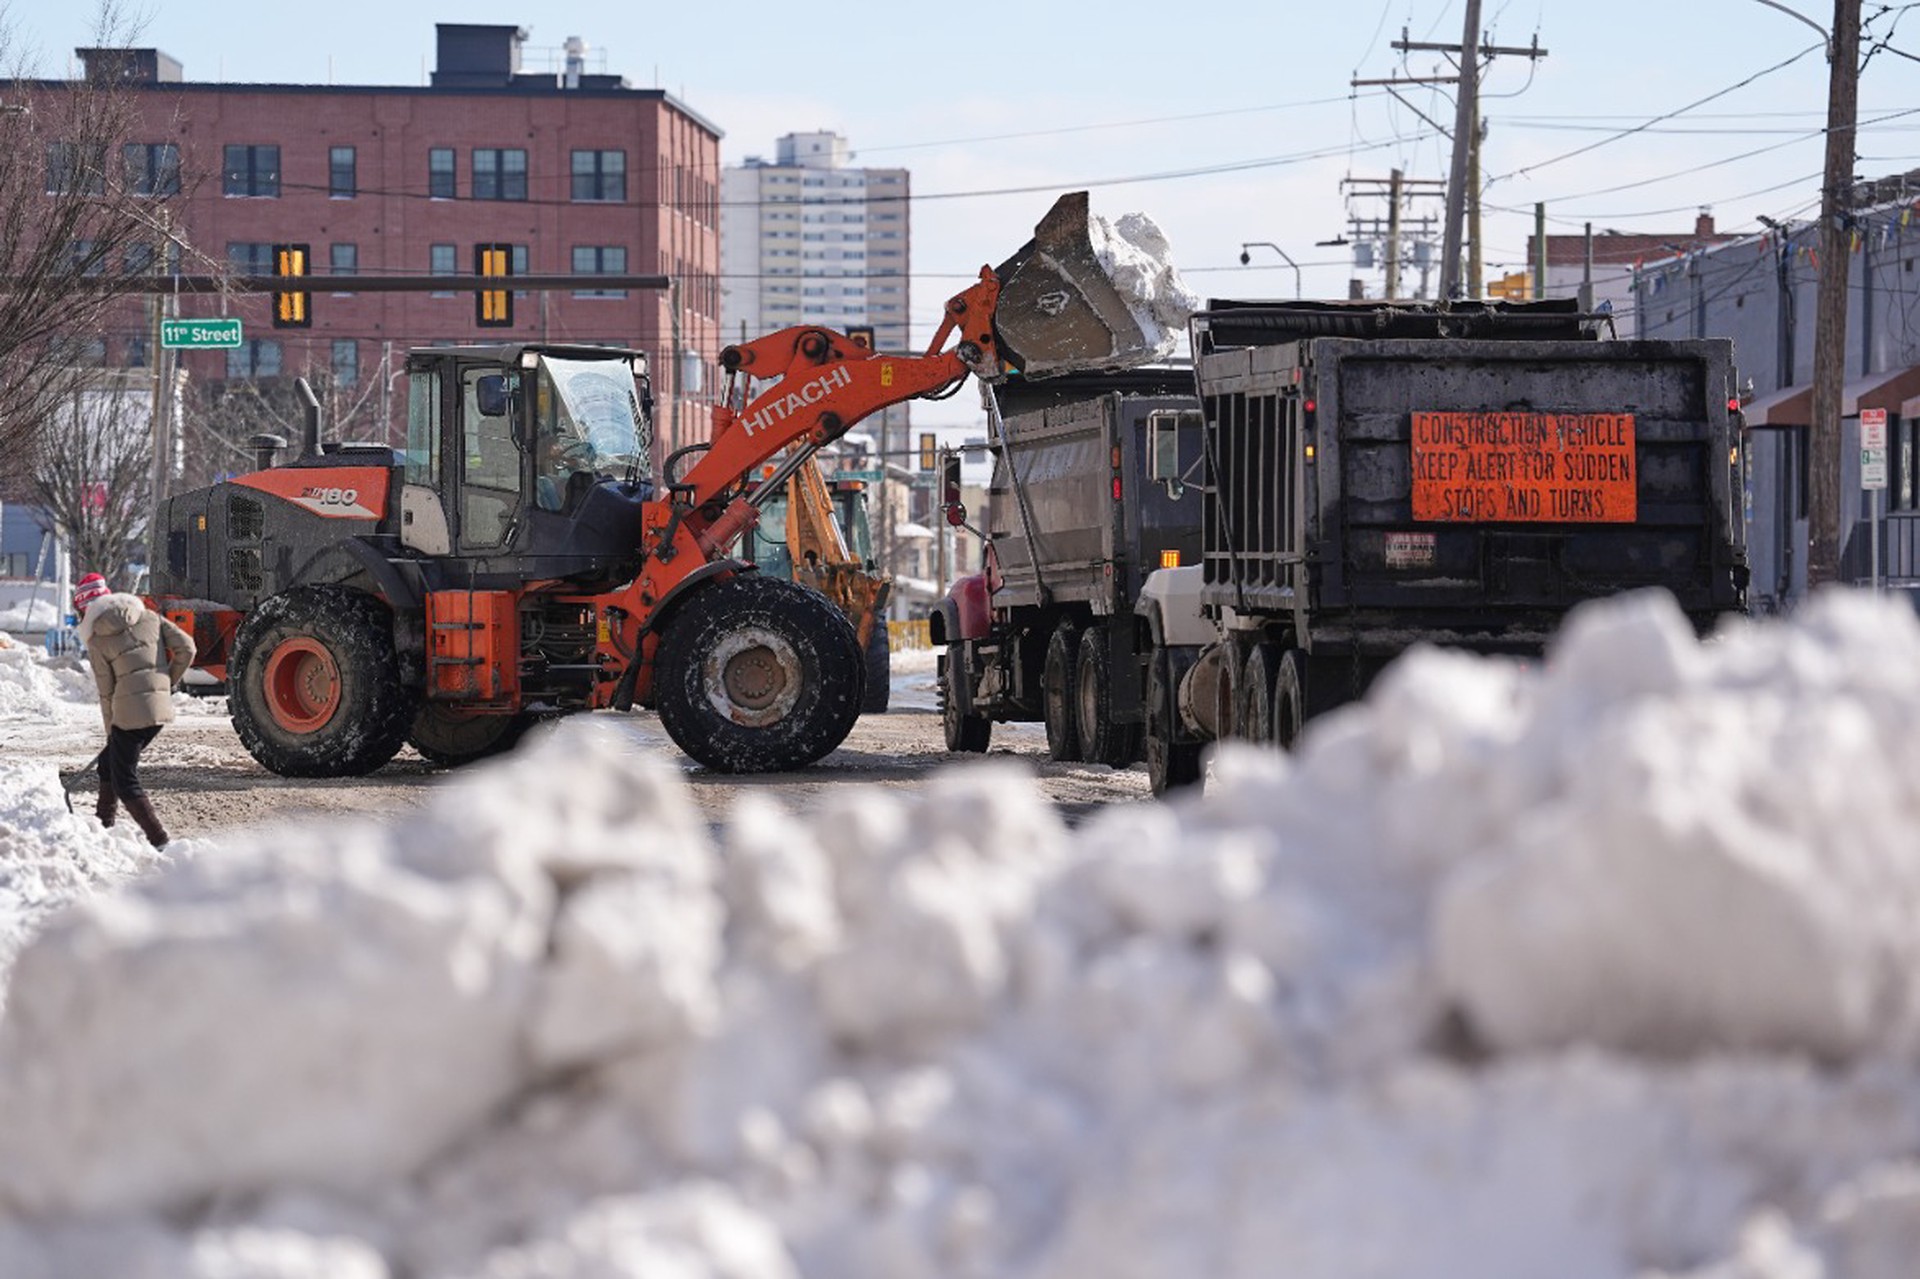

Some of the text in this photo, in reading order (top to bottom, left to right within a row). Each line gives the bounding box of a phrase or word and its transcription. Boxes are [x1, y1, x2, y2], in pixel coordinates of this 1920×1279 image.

[192, 327, 238, 342] Street
[740, 365, 853, 437] HITACHI
[1419, 415, 1626, 446] CONSTRUCTION VEHICLE
[1416, 452, 1630, 481] KEEP ALERT FOR SUDDEN
[1444, 488, 1605, 518] STOPS AND TURNS
